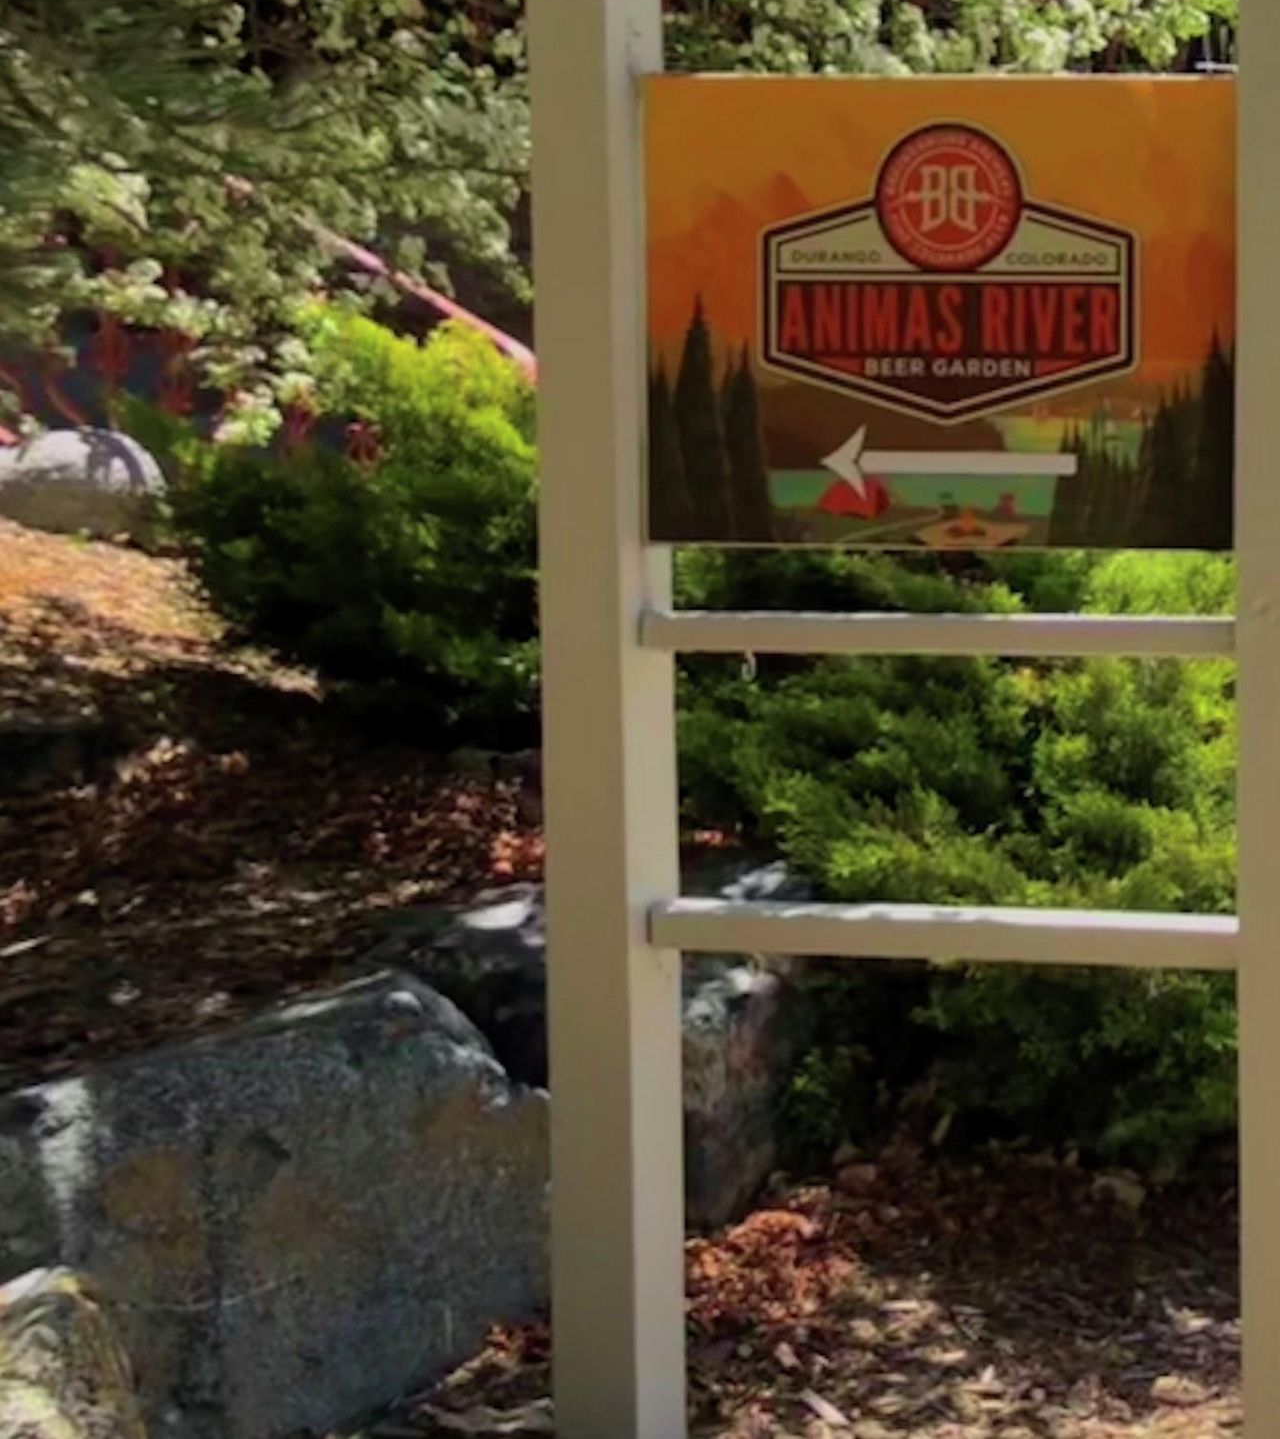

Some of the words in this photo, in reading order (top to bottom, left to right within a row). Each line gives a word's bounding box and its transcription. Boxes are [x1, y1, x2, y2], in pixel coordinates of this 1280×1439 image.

[790, 249, 882, 265] DURANGO
[1005, 250, 1109, 267] COLORADO
[780, 284, 965, 353] ANIMAS
[981, 284, 1118, 354] RIVER
[864, 358, 926, 378] BEER
[932, 358, 1032, 378] GARDEN
